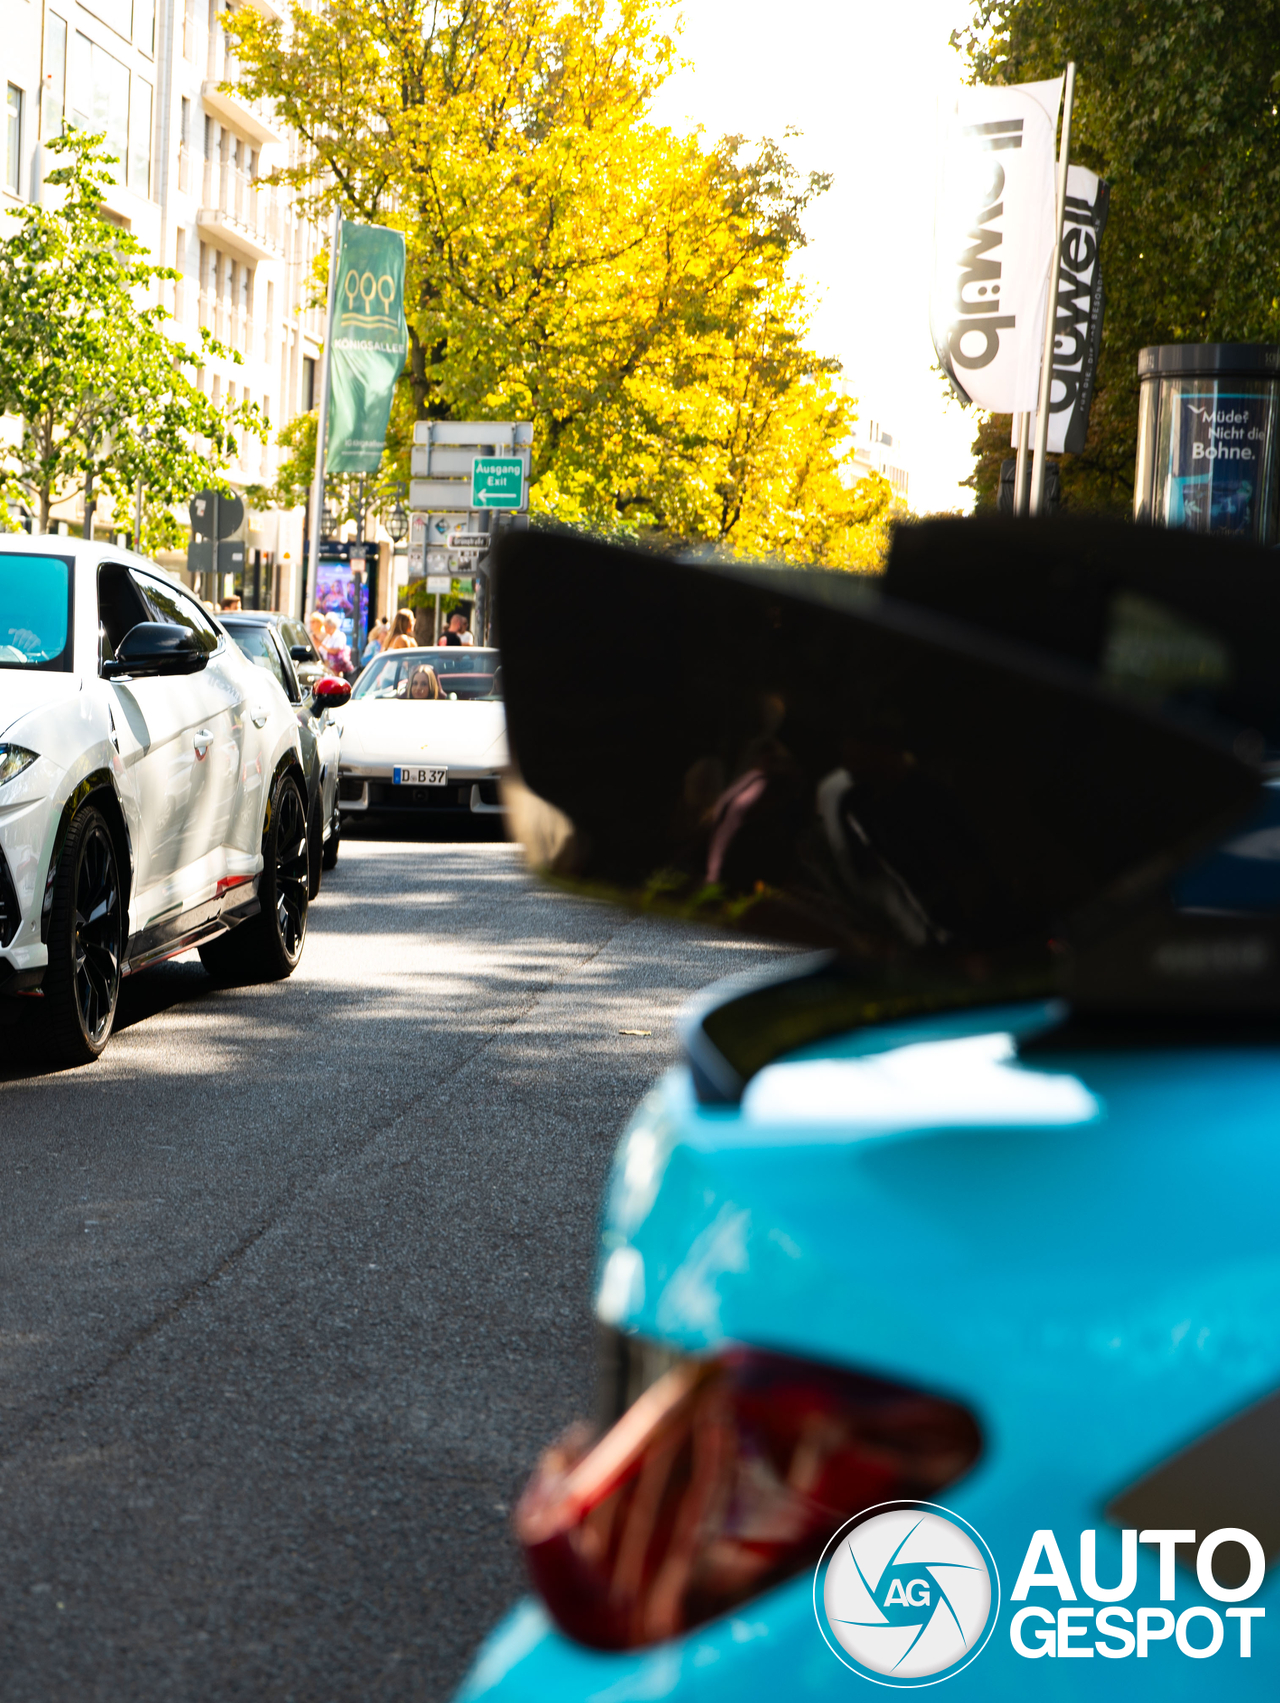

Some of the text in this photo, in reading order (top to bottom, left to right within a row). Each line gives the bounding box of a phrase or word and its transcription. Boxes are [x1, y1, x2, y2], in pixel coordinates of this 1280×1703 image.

[333, 337, 405, 354] KÖNIGSALLEE
[1202, 410, 1249, 424] Müde?
[1208, 426, 1266, 440] Nicht die
[1192, 442, 1256, 460] Bohne.
[475, 462, 520, 476] Ausgang
[487, 476, 507, 487] Exit
[402, 769, 445, 783] D B 37
